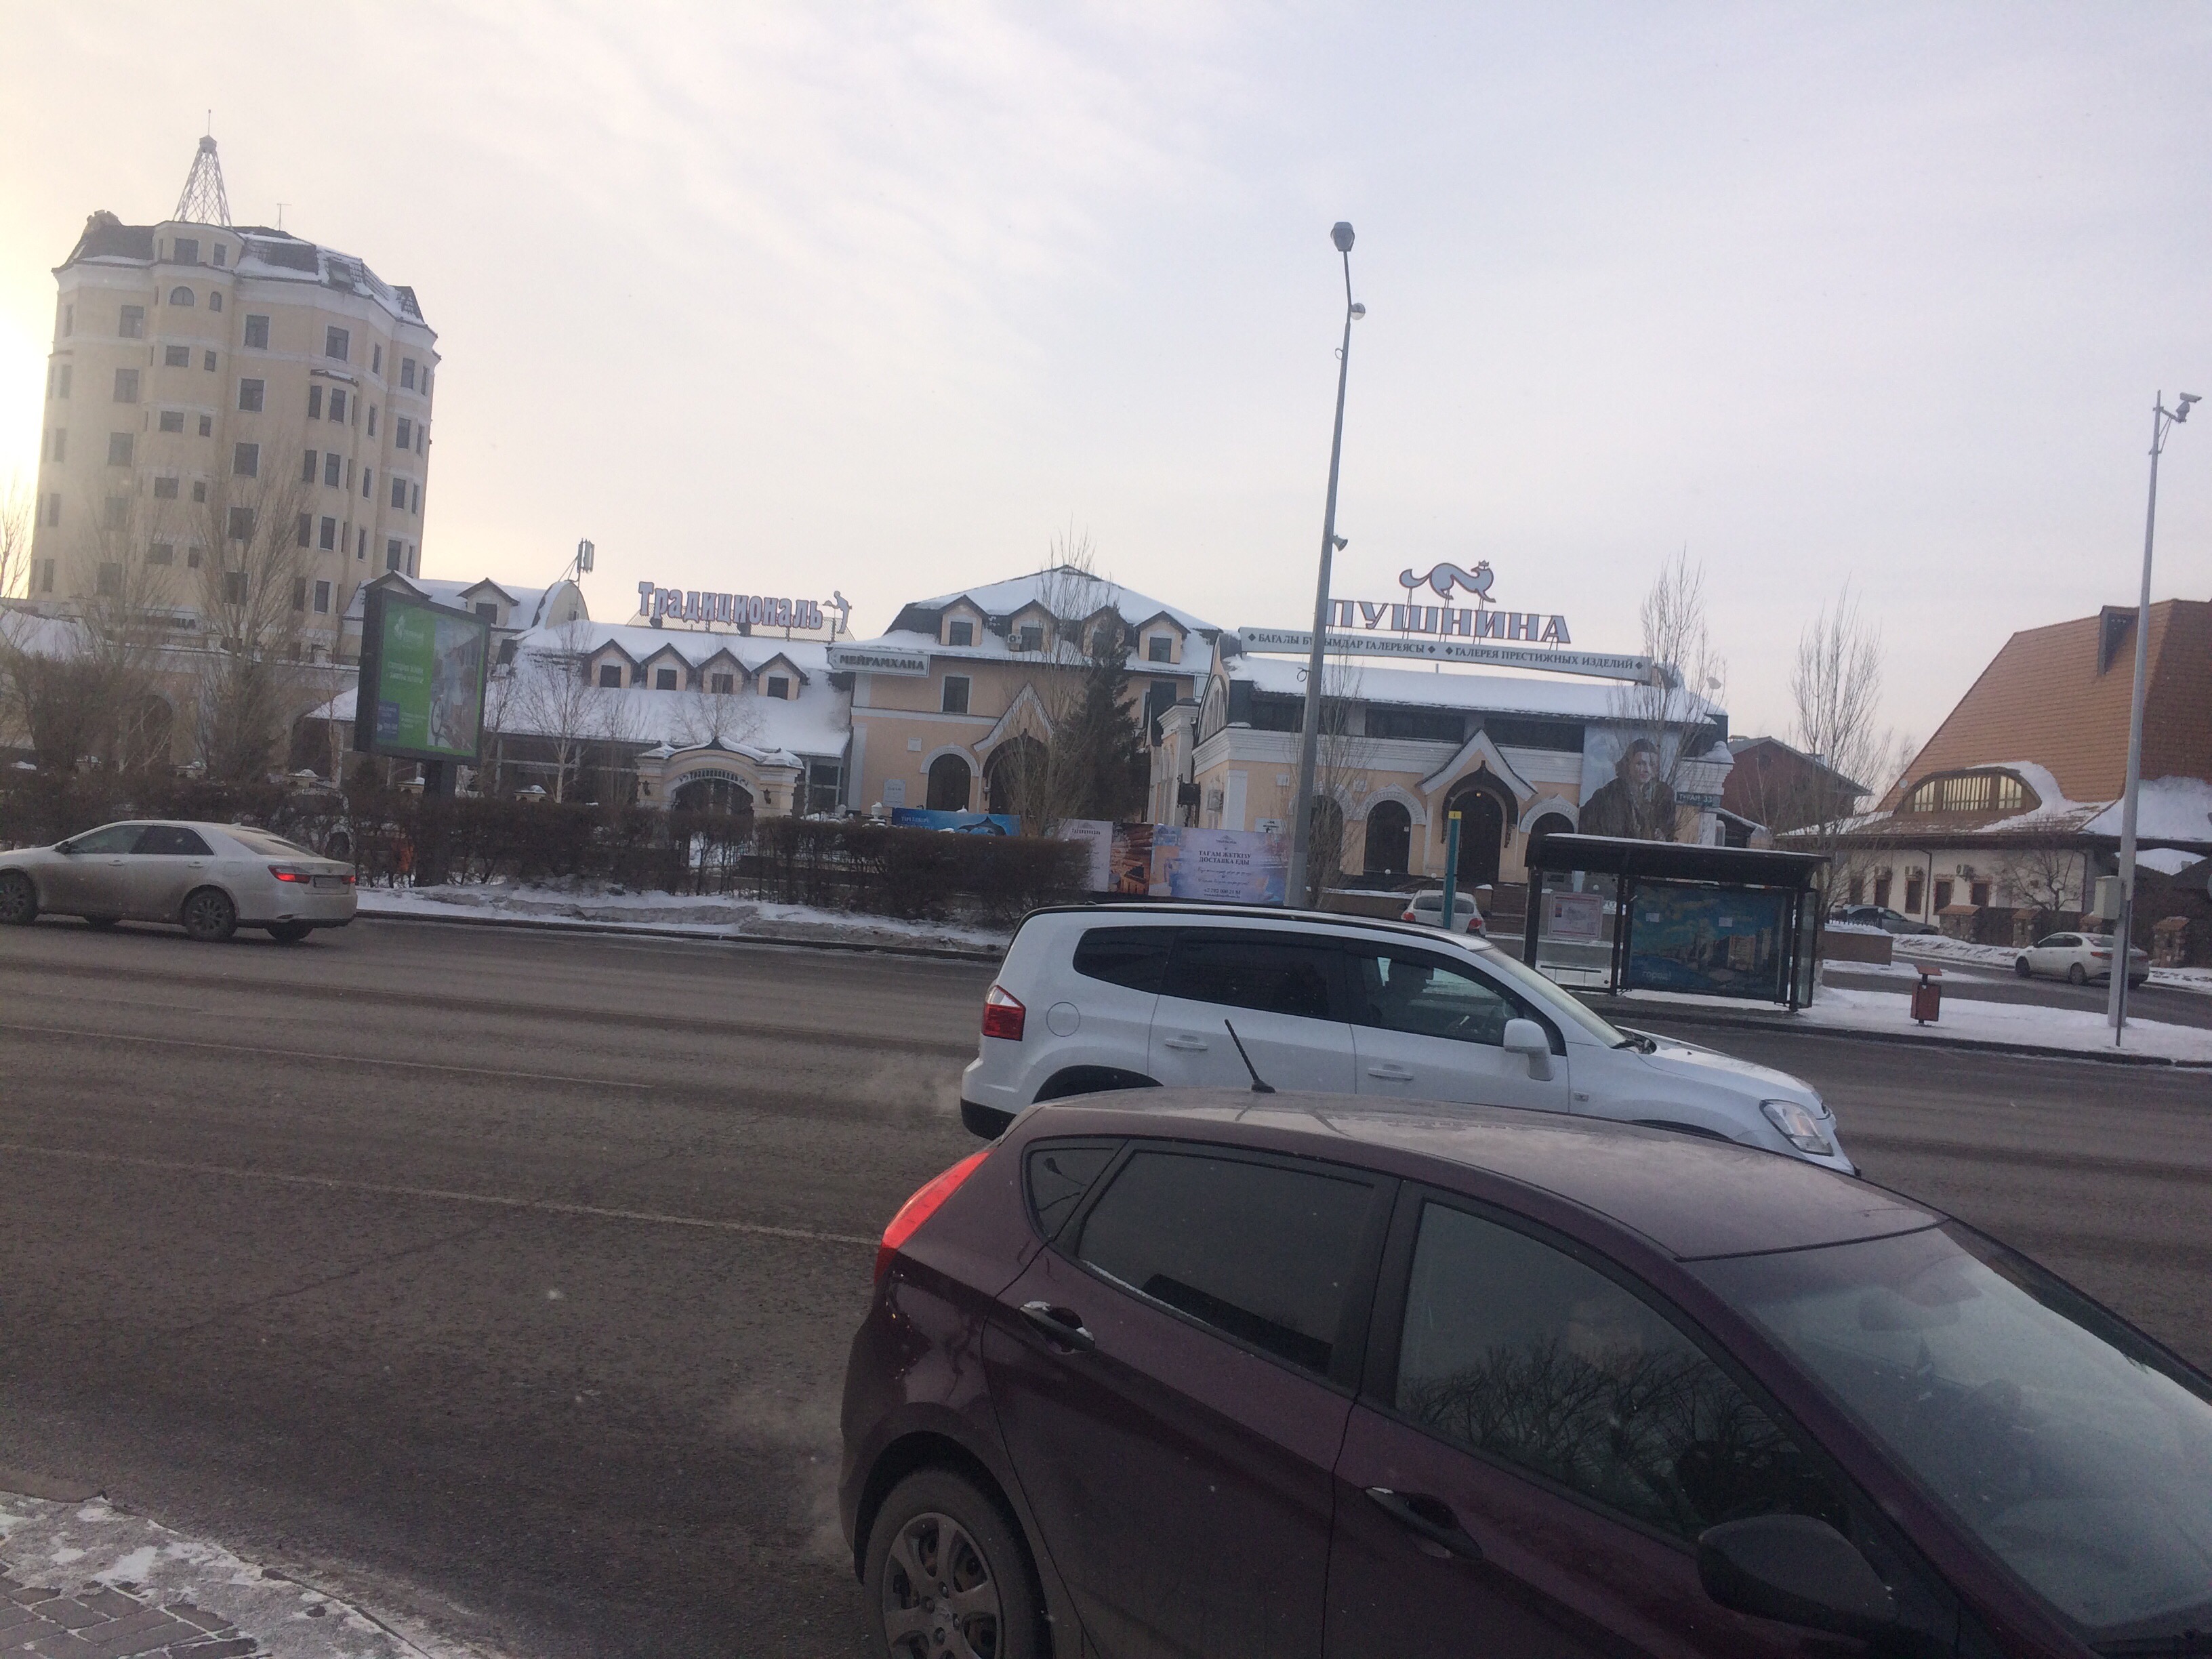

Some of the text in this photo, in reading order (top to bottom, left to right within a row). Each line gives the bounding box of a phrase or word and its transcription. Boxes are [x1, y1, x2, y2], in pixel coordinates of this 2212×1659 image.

[638, 581, 823, 630] Традициональ
[1326, 599, 1570, 644] ПУШНИНА
[1303, 637, 1362, 649] БЫМДАР
[840, 654, 924, 670] МЕЙРАМХАНА
[1455, 647, 1633, 670] ГАЛЕРЕЯ ПРЕСТИЖНЫХ ИЗДЕЛИЙ
